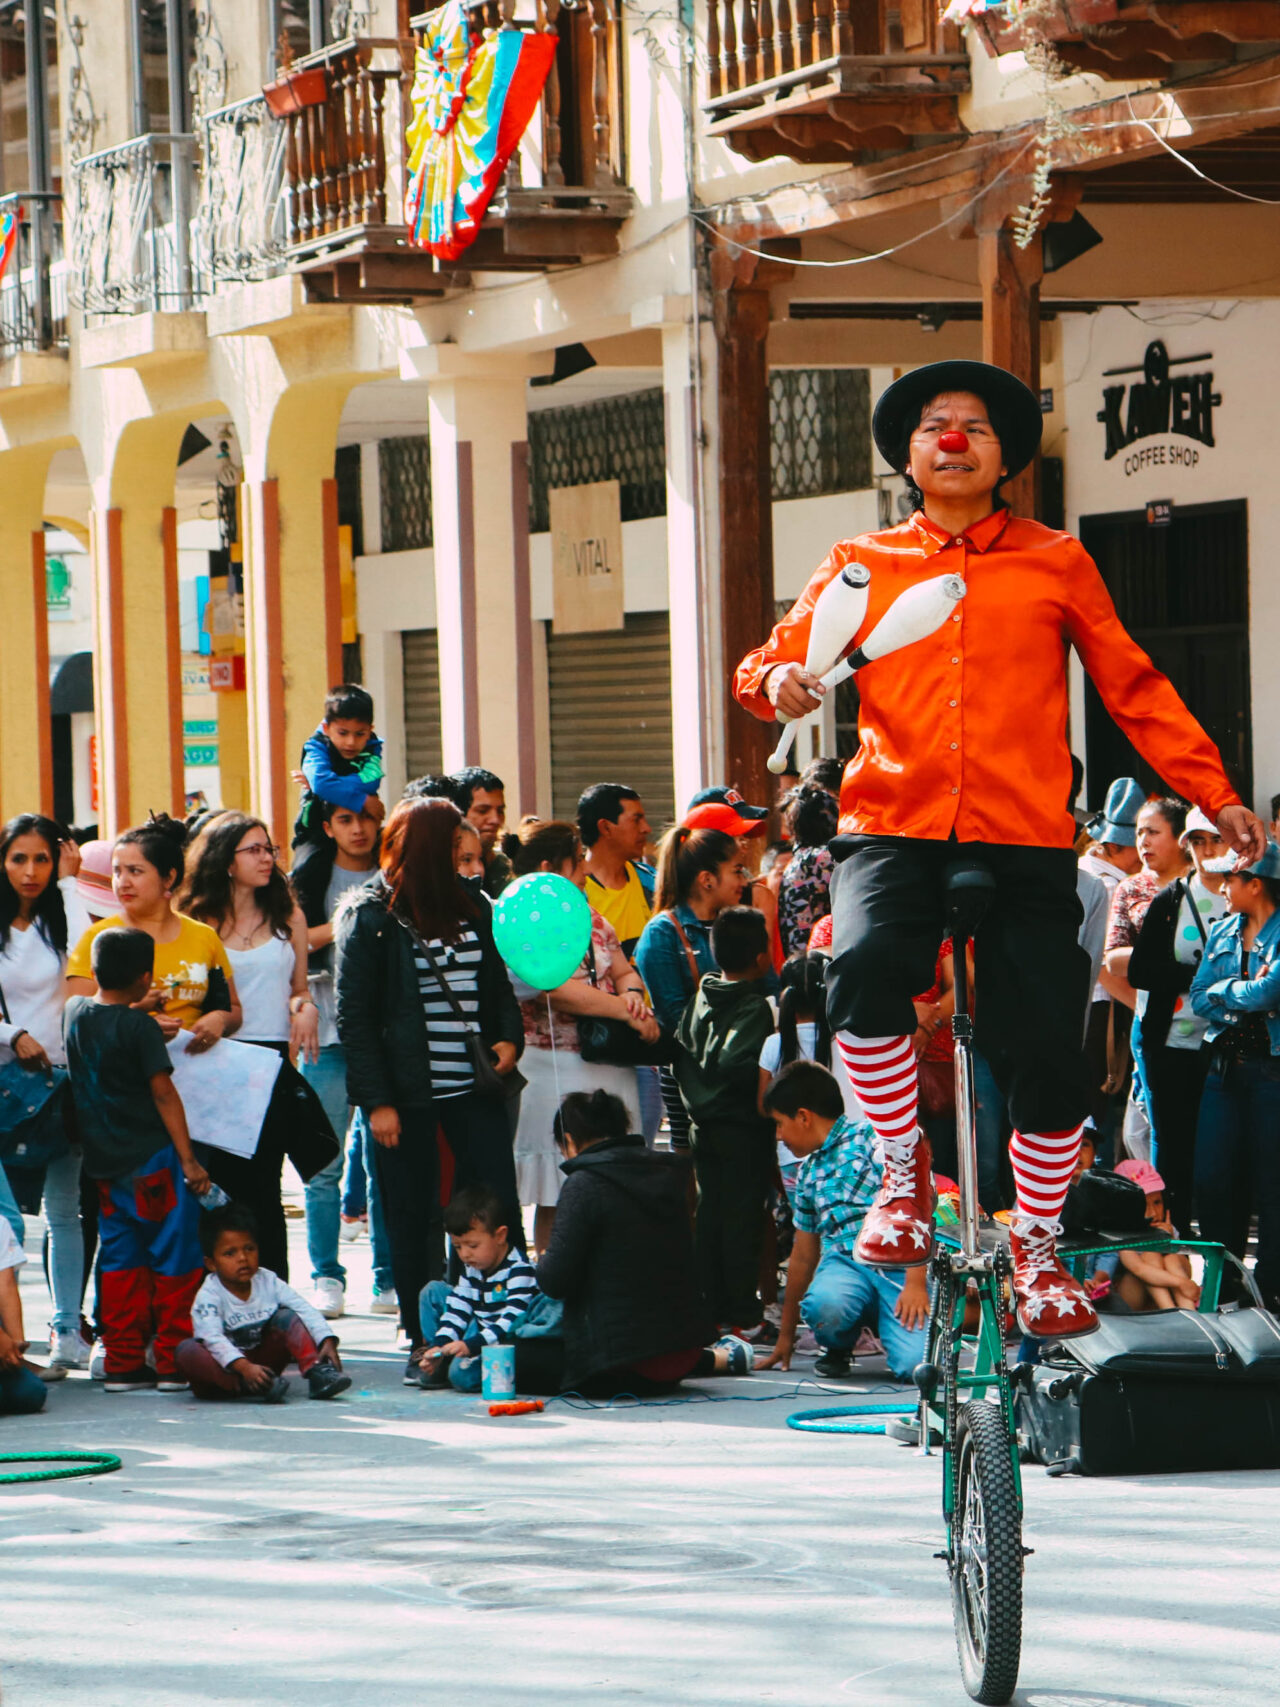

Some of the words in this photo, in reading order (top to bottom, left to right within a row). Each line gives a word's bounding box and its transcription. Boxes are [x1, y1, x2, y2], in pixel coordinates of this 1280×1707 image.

[1102, 371, 1216, 461] KAWEH
[1124, 445, 1166, 477] COFFEE
[1169, 444, 1200, 468] SHOP
[572, 536, 611, 577] VITAL
